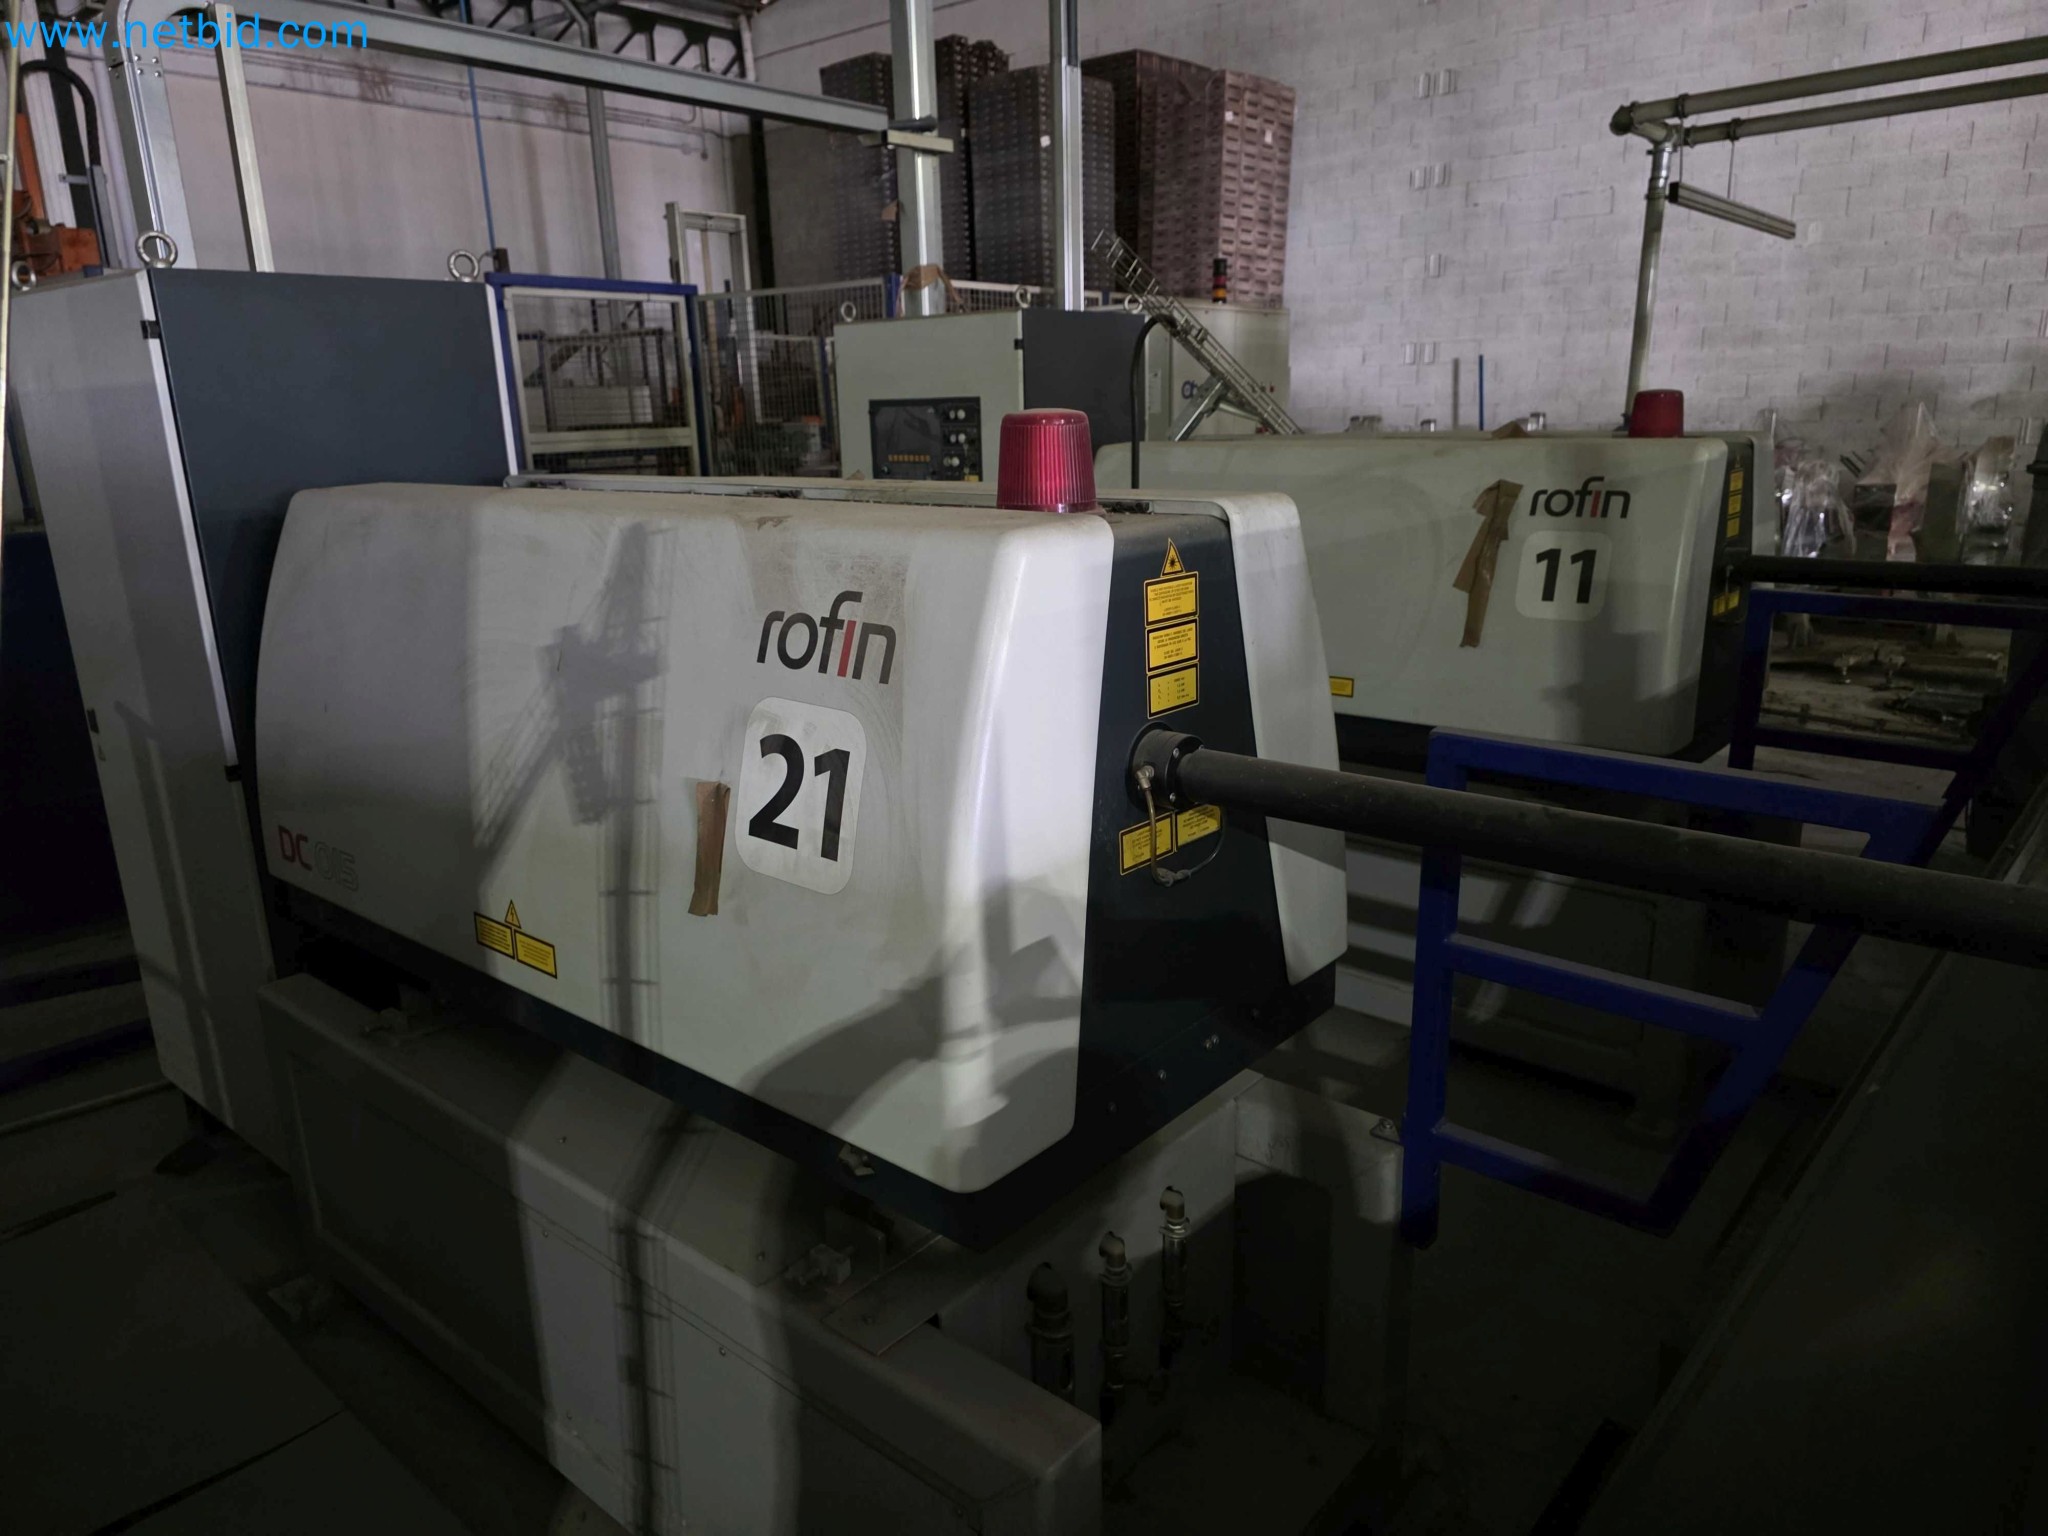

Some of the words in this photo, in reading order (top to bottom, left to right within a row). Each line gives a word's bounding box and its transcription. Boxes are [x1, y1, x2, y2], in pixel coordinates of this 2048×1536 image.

[1529, 476, 1631, 519] rofin
[1536, 548, 1597, 604] 11
[756, 590, 897, 685] rofin
[748, 733, 851, 862] 21
